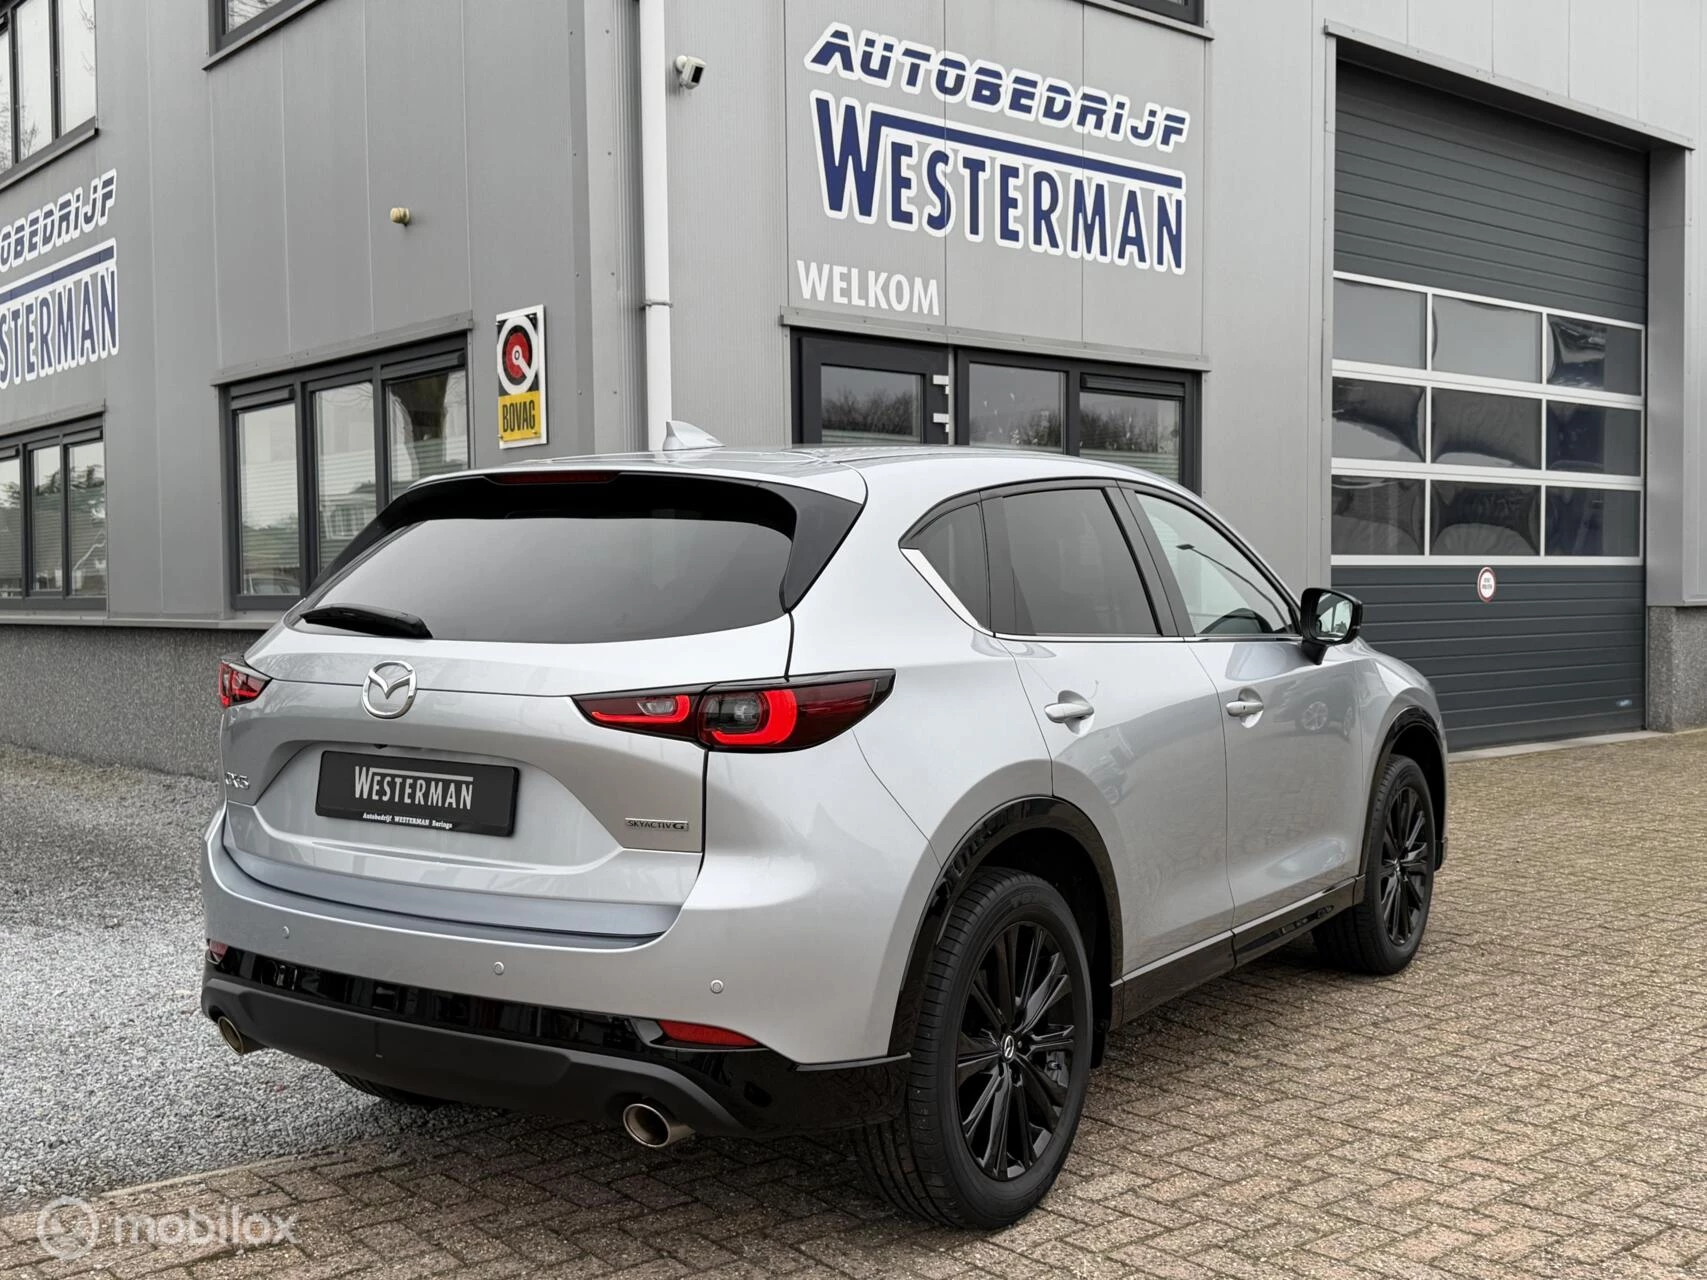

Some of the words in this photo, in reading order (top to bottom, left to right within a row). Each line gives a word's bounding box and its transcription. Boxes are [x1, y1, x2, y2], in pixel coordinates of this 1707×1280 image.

[807, 25, 1189, 149] AUTOBEDRIJF
[812, 93, 1186, 272] WESTERMAN
[797, 260, 940, 316] WELKOM
[502, 400, 536, 432] BOVAG
[354, 765, 474, 810] WESTERMAN
[393, 815, 430, 826] WESTERMAN
